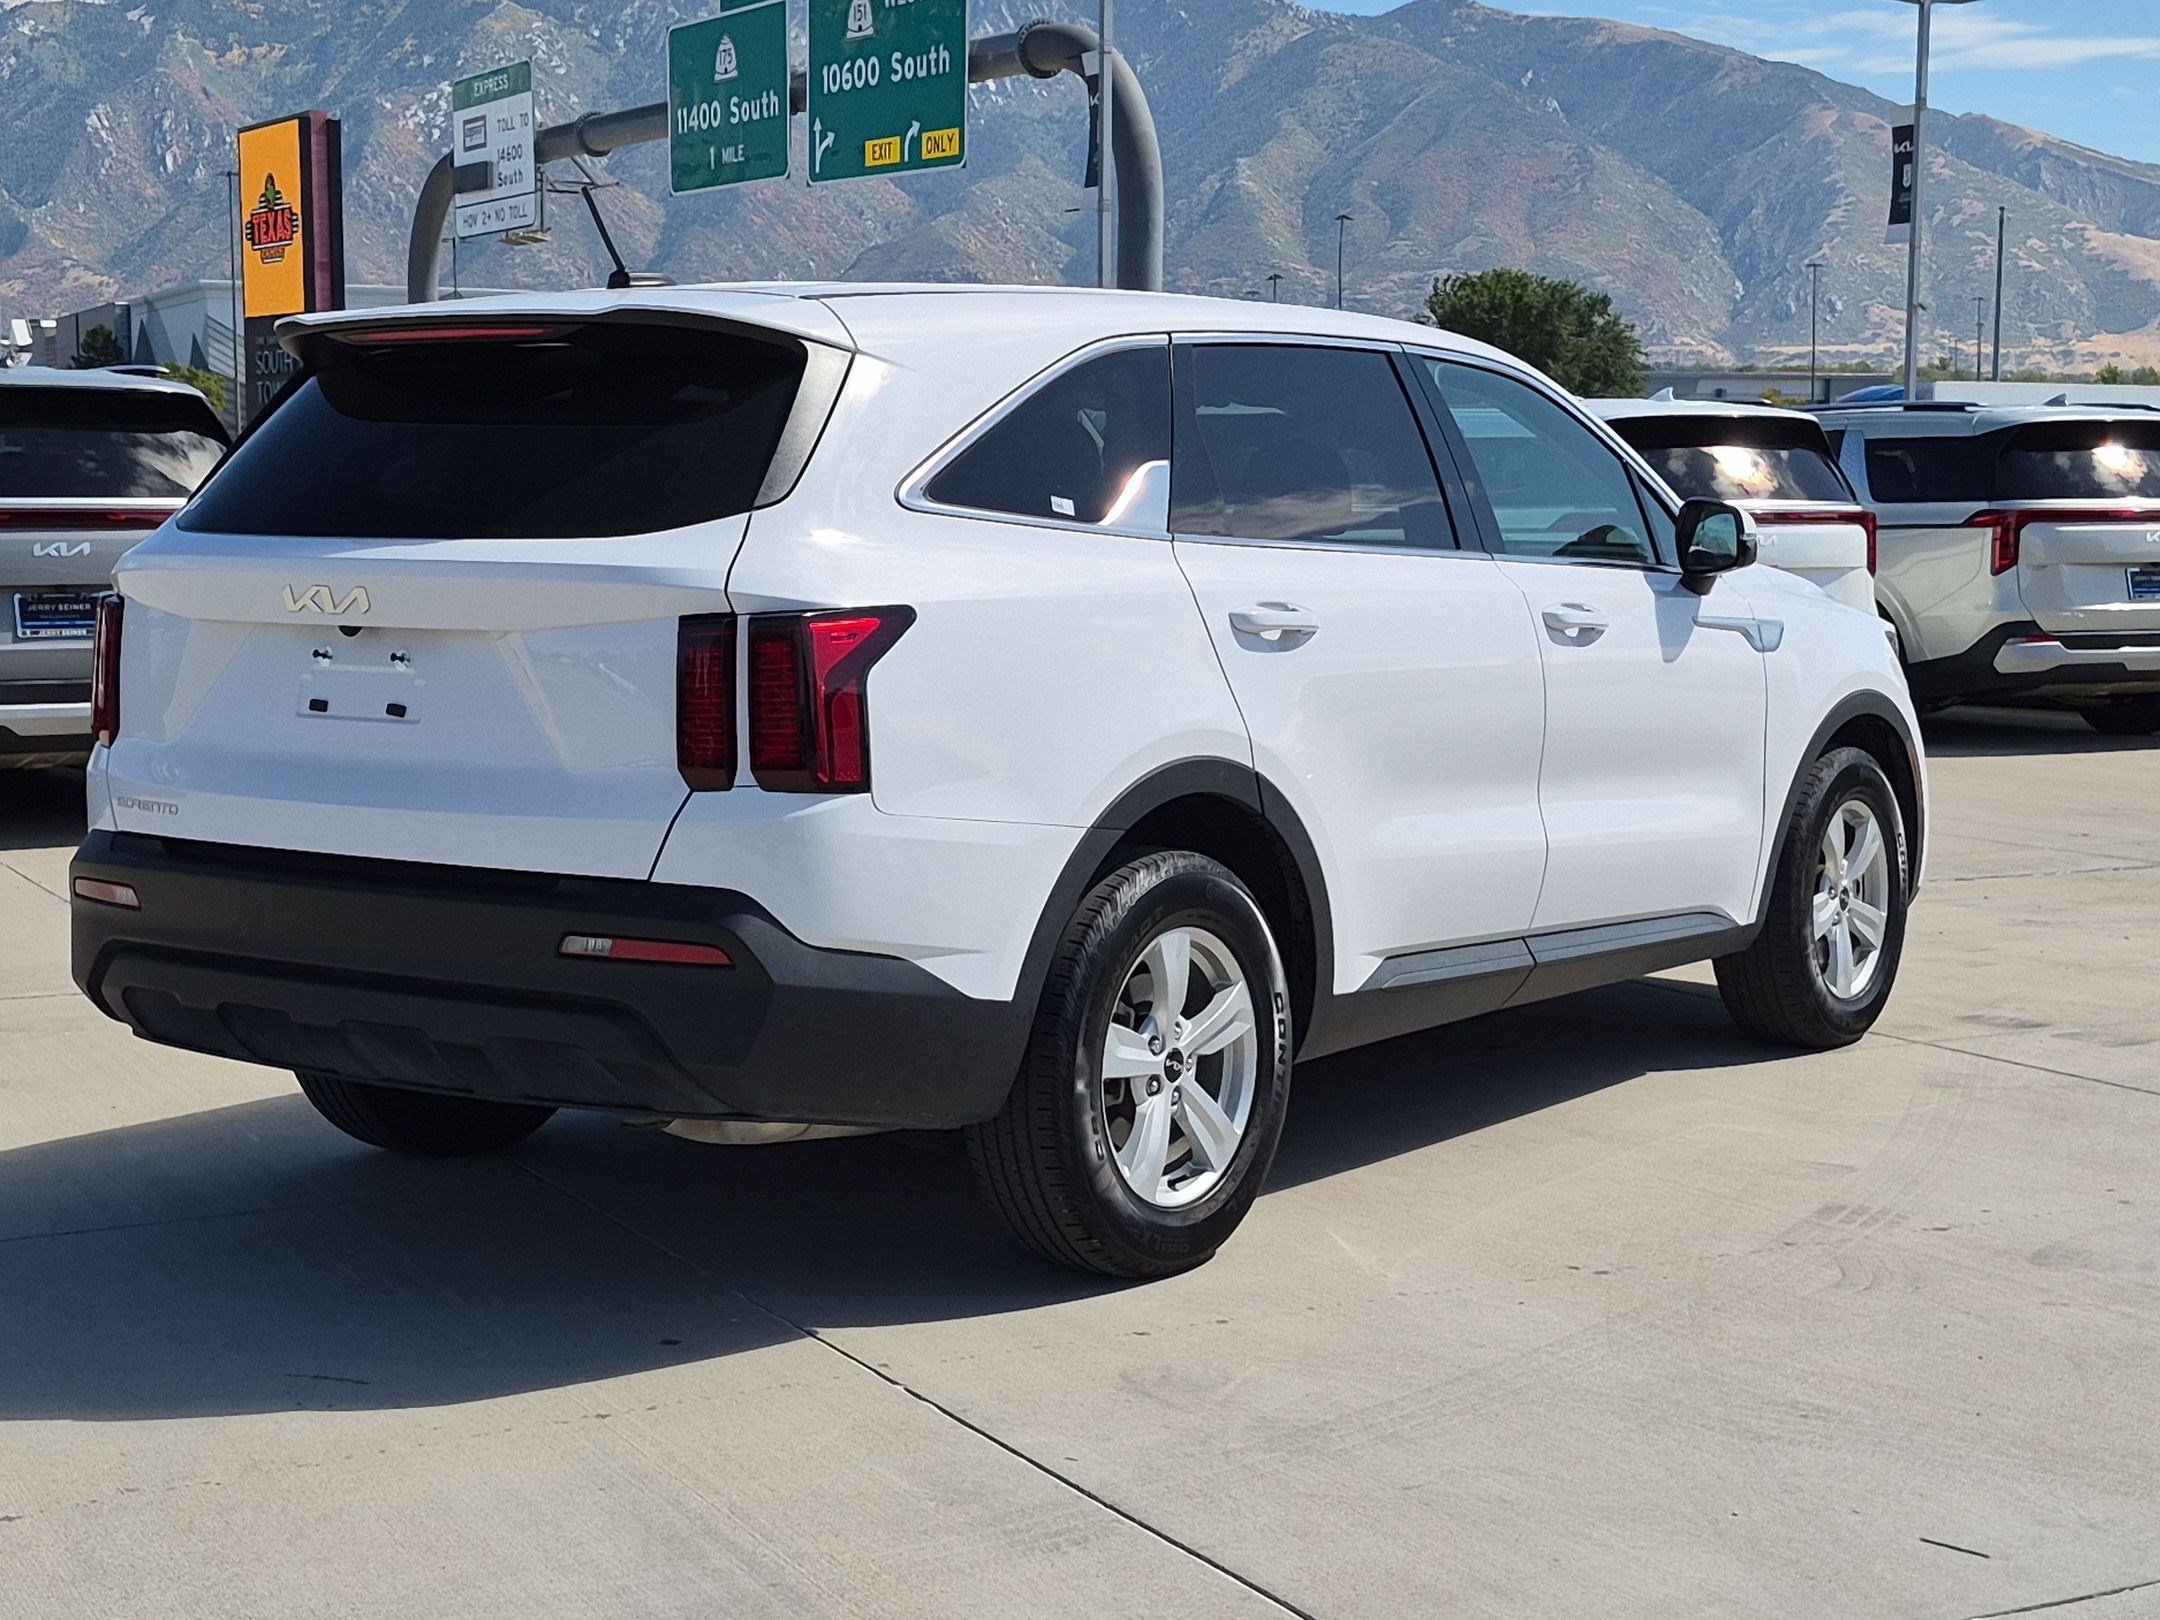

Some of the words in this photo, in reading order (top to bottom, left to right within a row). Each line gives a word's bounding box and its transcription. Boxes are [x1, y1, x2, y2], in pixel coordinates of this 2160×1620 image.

[853, 4, 867, 23] 151
[718, 49, 733, 66] 175
[822, 56, 880, 94] 10600
[890, 43, 951, 83] South
[473, 73, 510, 98] EXPRESS
[497, 116, 516, 133] TOLL
[519, 112, 530, 128] TO
[677, 100, 721, 135] 11400
[729, 89, 780, 125] South
[497, 143, 523, 163] 14600
[709, 146, 715, 170] 1
[721, 144, 745, 166] MILE
[871, 142, 893, 161] EXIT
[925, 135, 954, 156] ONLY
[498, 169, 524, 187] South
[252, 208, 292, 245] TEXAS
[463, 212, 477, 228] HOV
[481, 211, 491, 226] 2+
[495, 208, 506, 224] NO
[509, 204, 528, 220] TOLL
[255, 349, 294, 375] SOUTH
[32, 541, 91, 557] KIA
[28, 603, 56, 611] JERRY
[58, 602, 91, 611] SEINER
[281, 583, 372, 615] KIA
[117, 795, 179, 816] SORENTO
